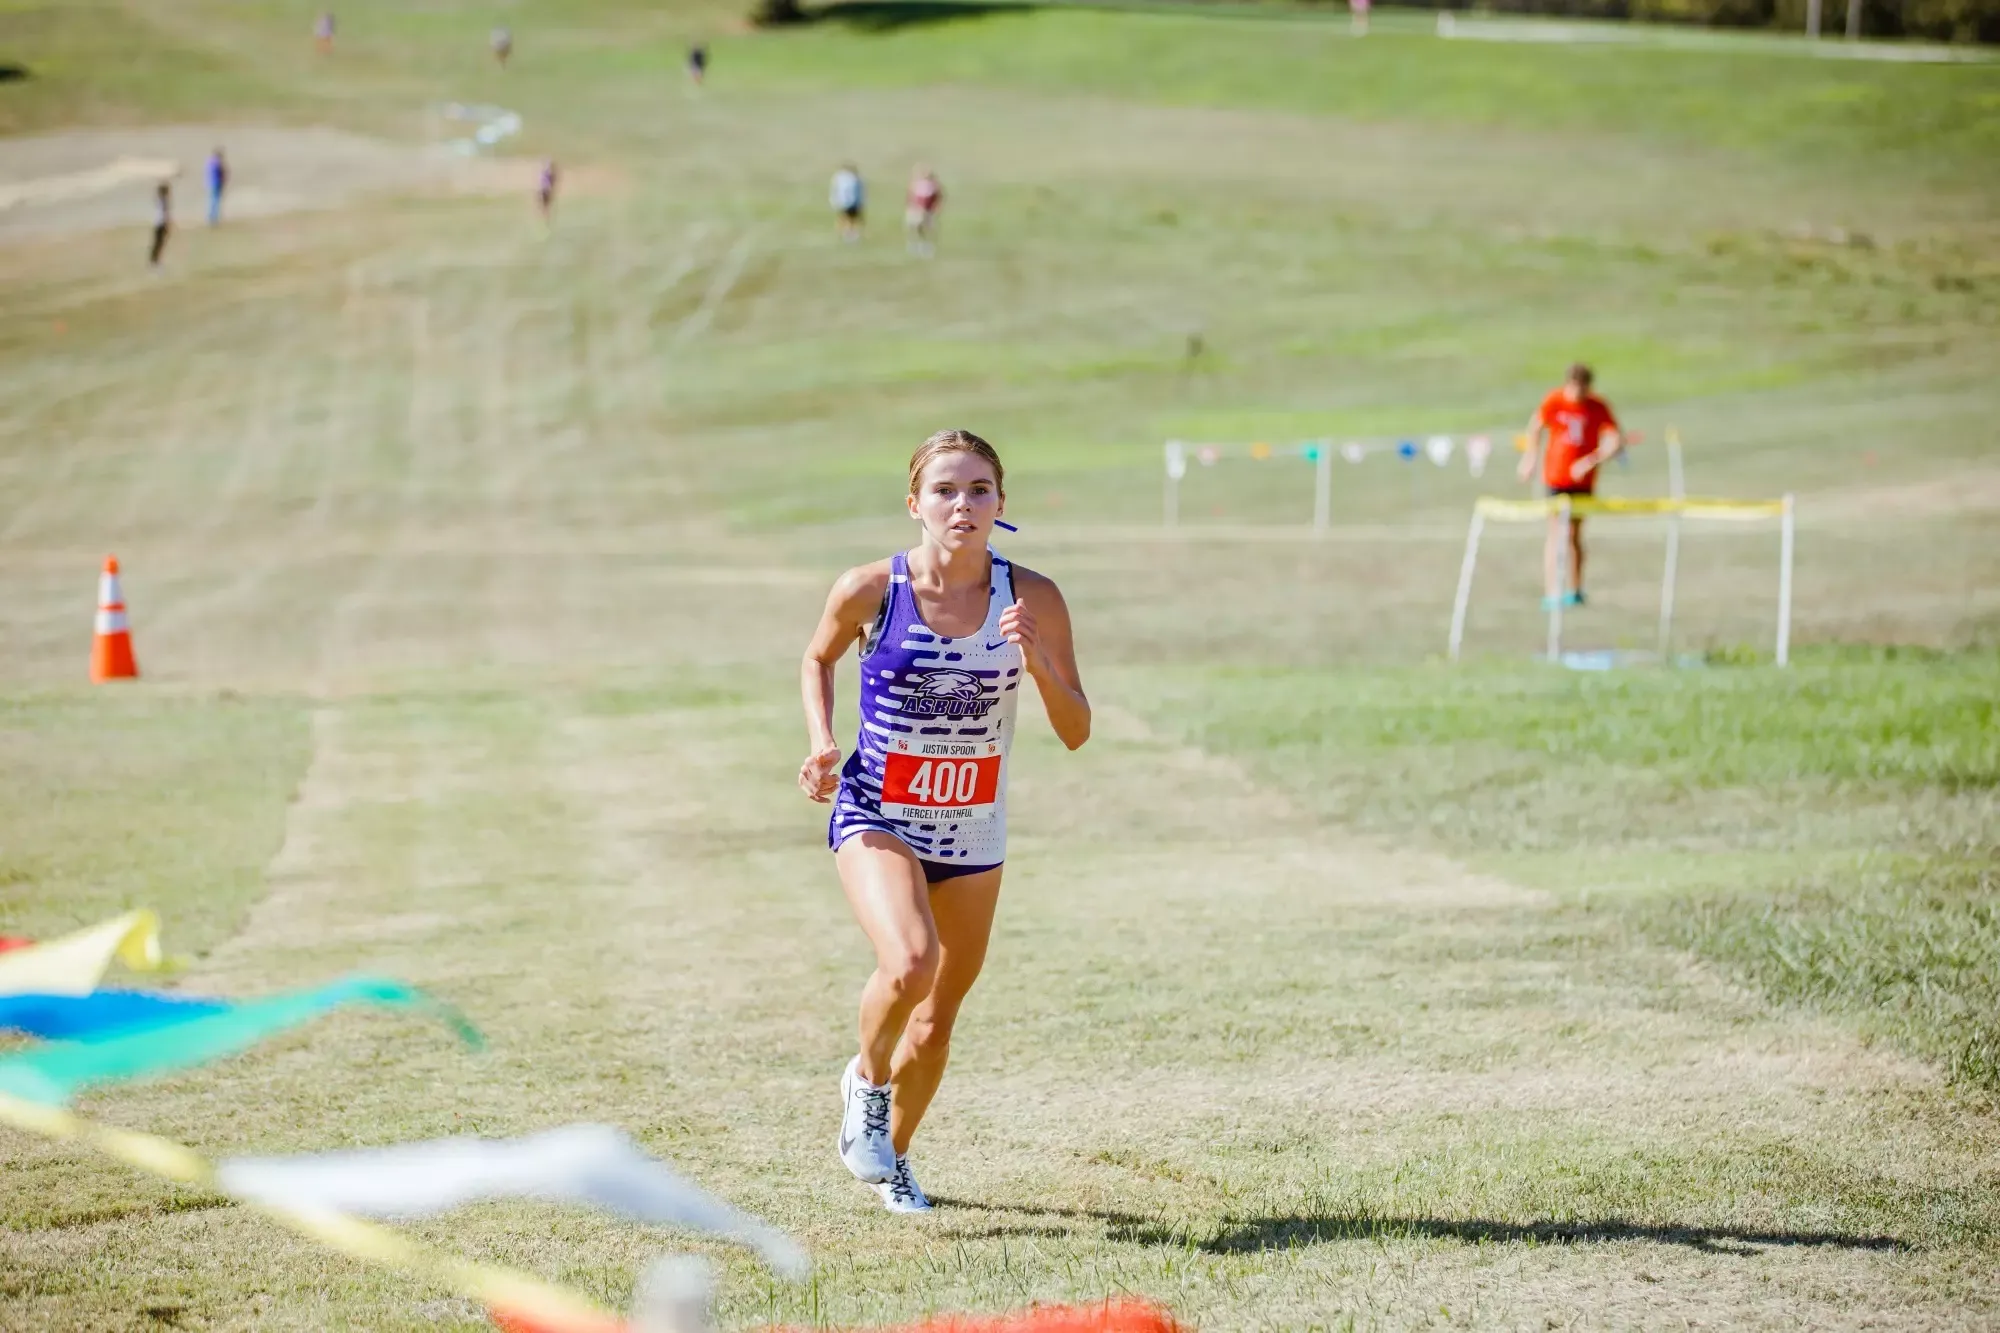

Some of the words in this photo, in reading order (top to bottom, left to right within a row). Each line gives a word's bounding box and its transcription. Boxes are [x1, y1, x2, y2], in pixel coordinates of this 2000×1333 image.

[902, 697, 997, 716] ASBURY
[921, 743, 949, 755] JUSTIN
[950, 745, 977, 755] SPOON
[907, 760, 979, 803] 400
[902, 807, 940, 819] FIERCELY
[940, 808, 973, 819] FAITHFUL
